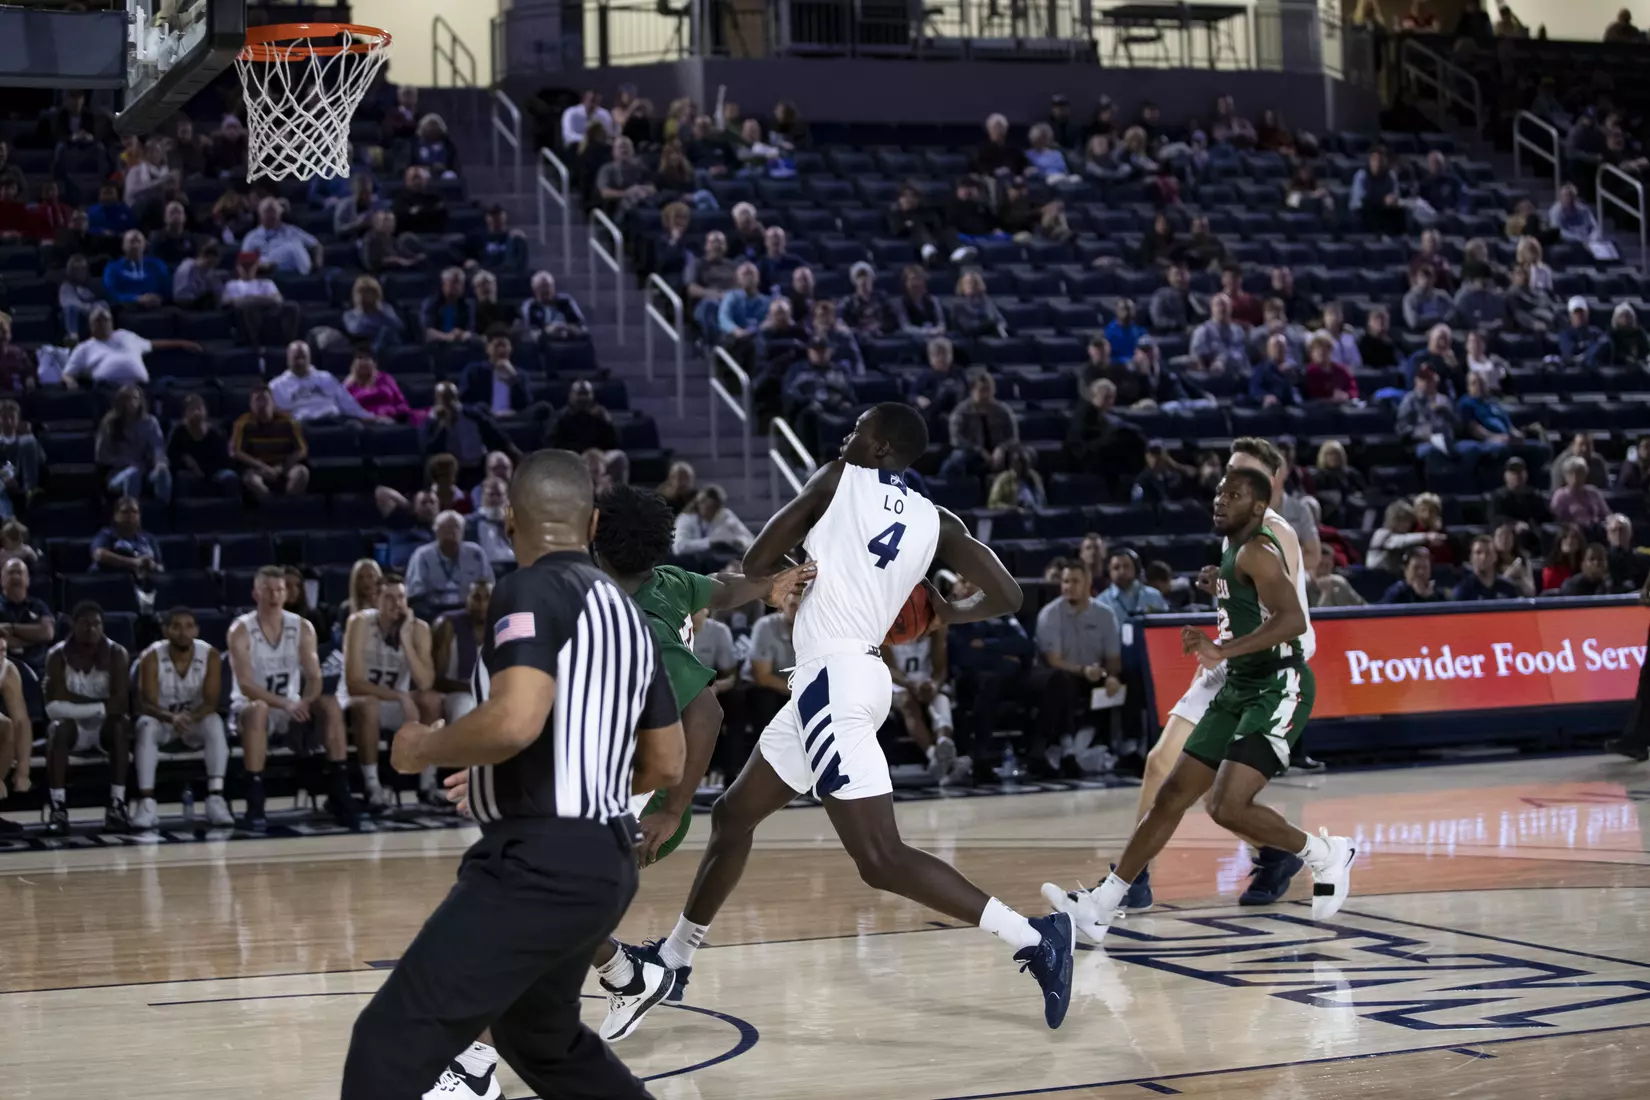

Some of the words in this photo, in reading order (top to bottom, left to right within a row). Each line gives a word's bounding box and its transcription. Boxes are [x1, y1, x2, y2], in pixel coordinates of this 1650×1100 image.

[884, 495, 904, 515] LO
[867, 521, 907, 570] 4
[1345, 644, 1486, 685] Provider
[1491, 638, 1577, 676] Food
[265, 672, 290, 696] 12
